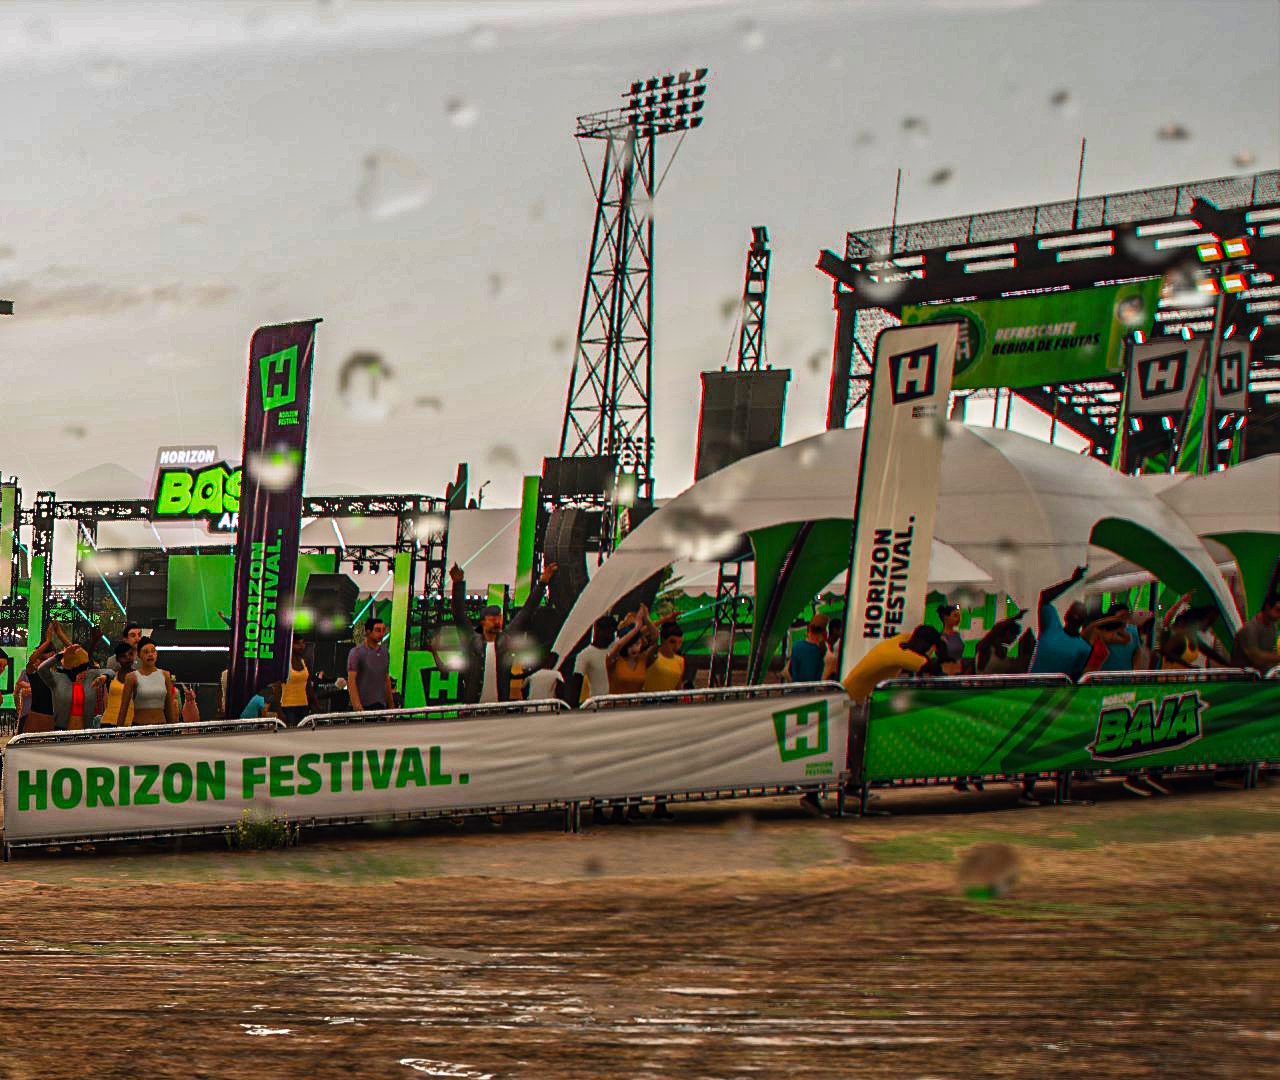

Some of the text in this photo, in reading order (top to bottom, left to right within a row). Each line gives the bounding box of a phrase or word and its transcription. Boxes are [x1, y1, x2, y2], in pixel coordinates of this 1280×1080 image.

[266, 357, 291, 399] H
[897, 354, 931, 395] H
[1146, 360, 1179, 391] H
[1222, 359, 1239, 388] H
[160, 450, 215, 463] HORIZON
[157, 467, 242, 514] BAS
[244, 542, 264, 658] HORIZON
[260, 529, 283, 659] FESTIVAL.
[864, 528, 892, 639] HORIZON
[884, 515, 916, 639] FESTIVAL.
[784, 711, 820, 751] H
[1095, 694, 1198, 753] BAJA
[18, 745, 470, 812] HORIZON FESTIVAL.
